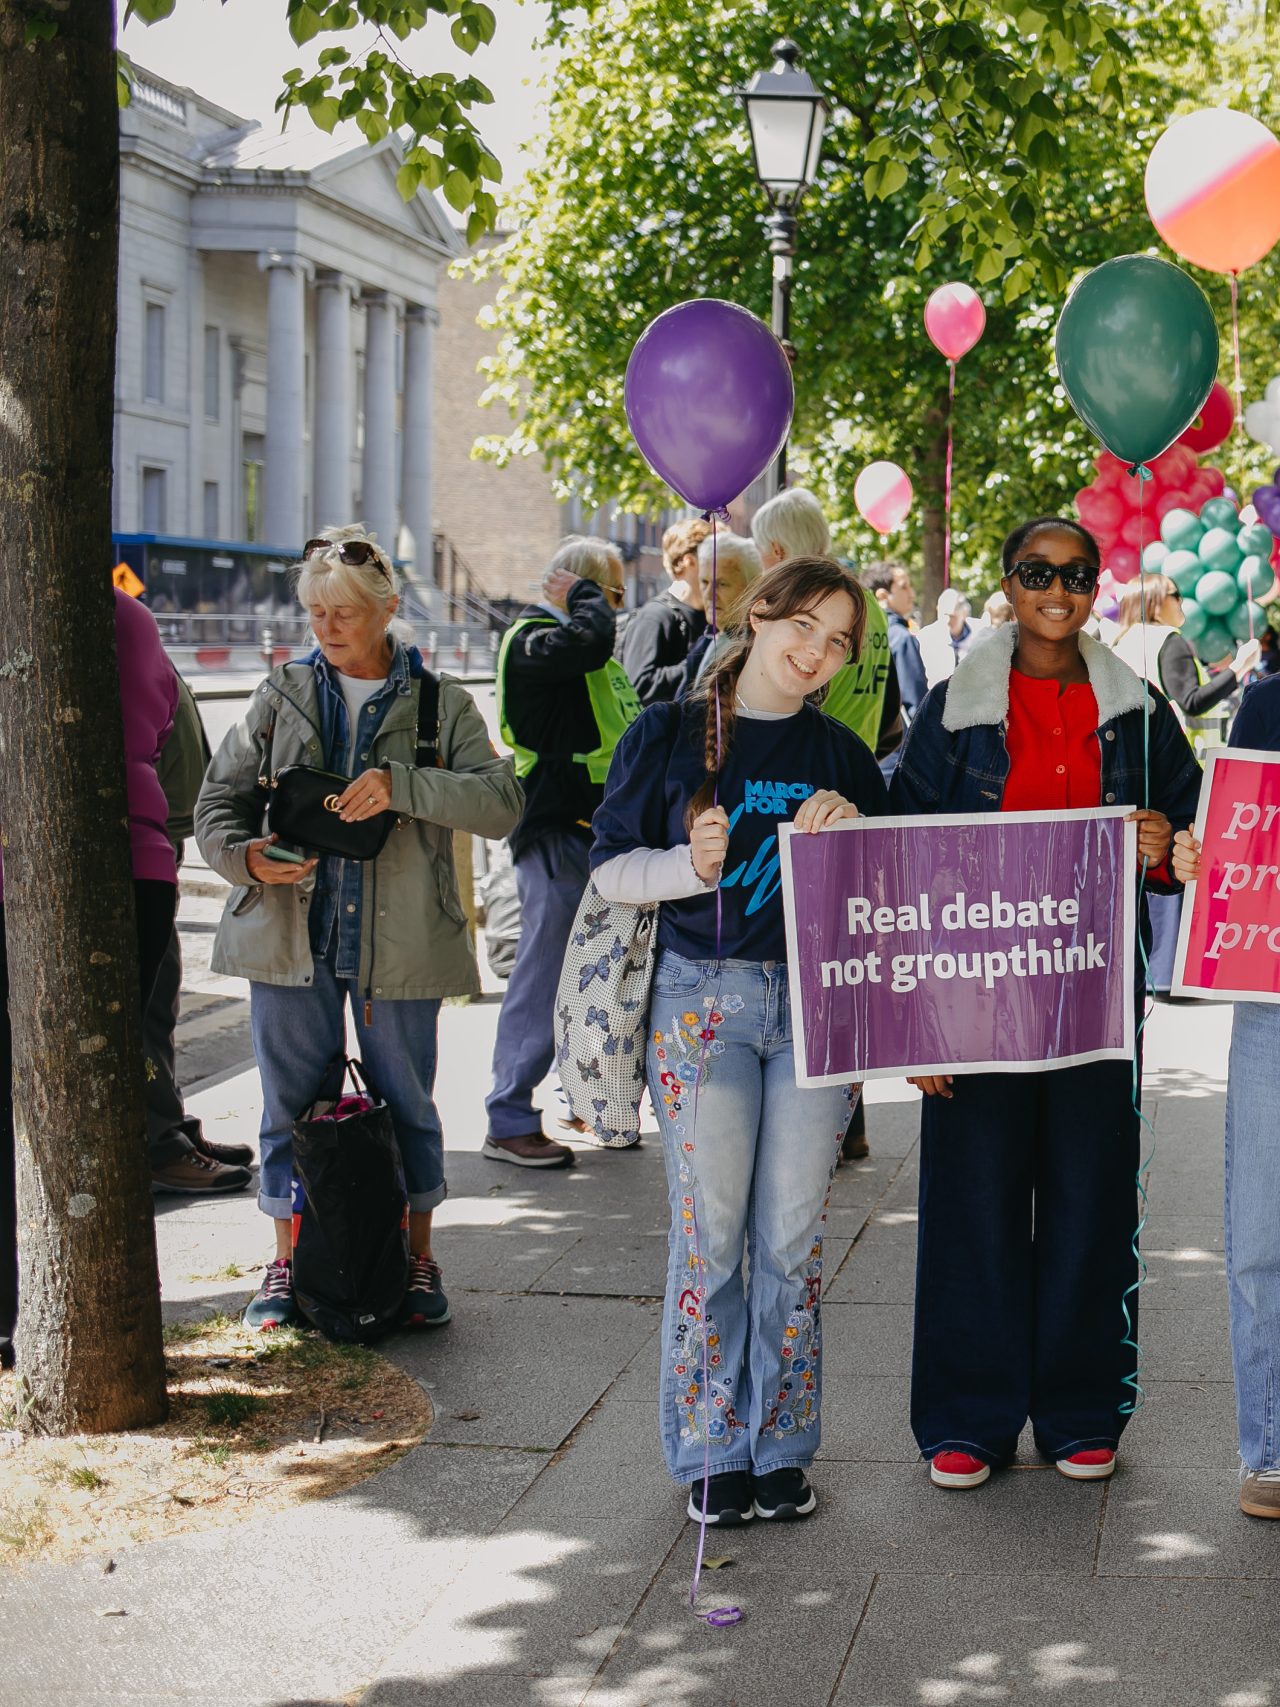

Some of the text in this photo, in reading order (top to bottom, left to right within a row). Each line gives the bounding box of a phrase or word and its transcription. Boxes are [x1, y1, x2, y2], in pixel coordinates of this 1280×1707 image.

[853, 664, 888, 695] LIF
[744, 780, 815, 800] MARCH
[745, 797, 788, 815] FOR
[847, 890, 1080, 935] Real debate
[821, 933, 1106, 993] not groupthink
